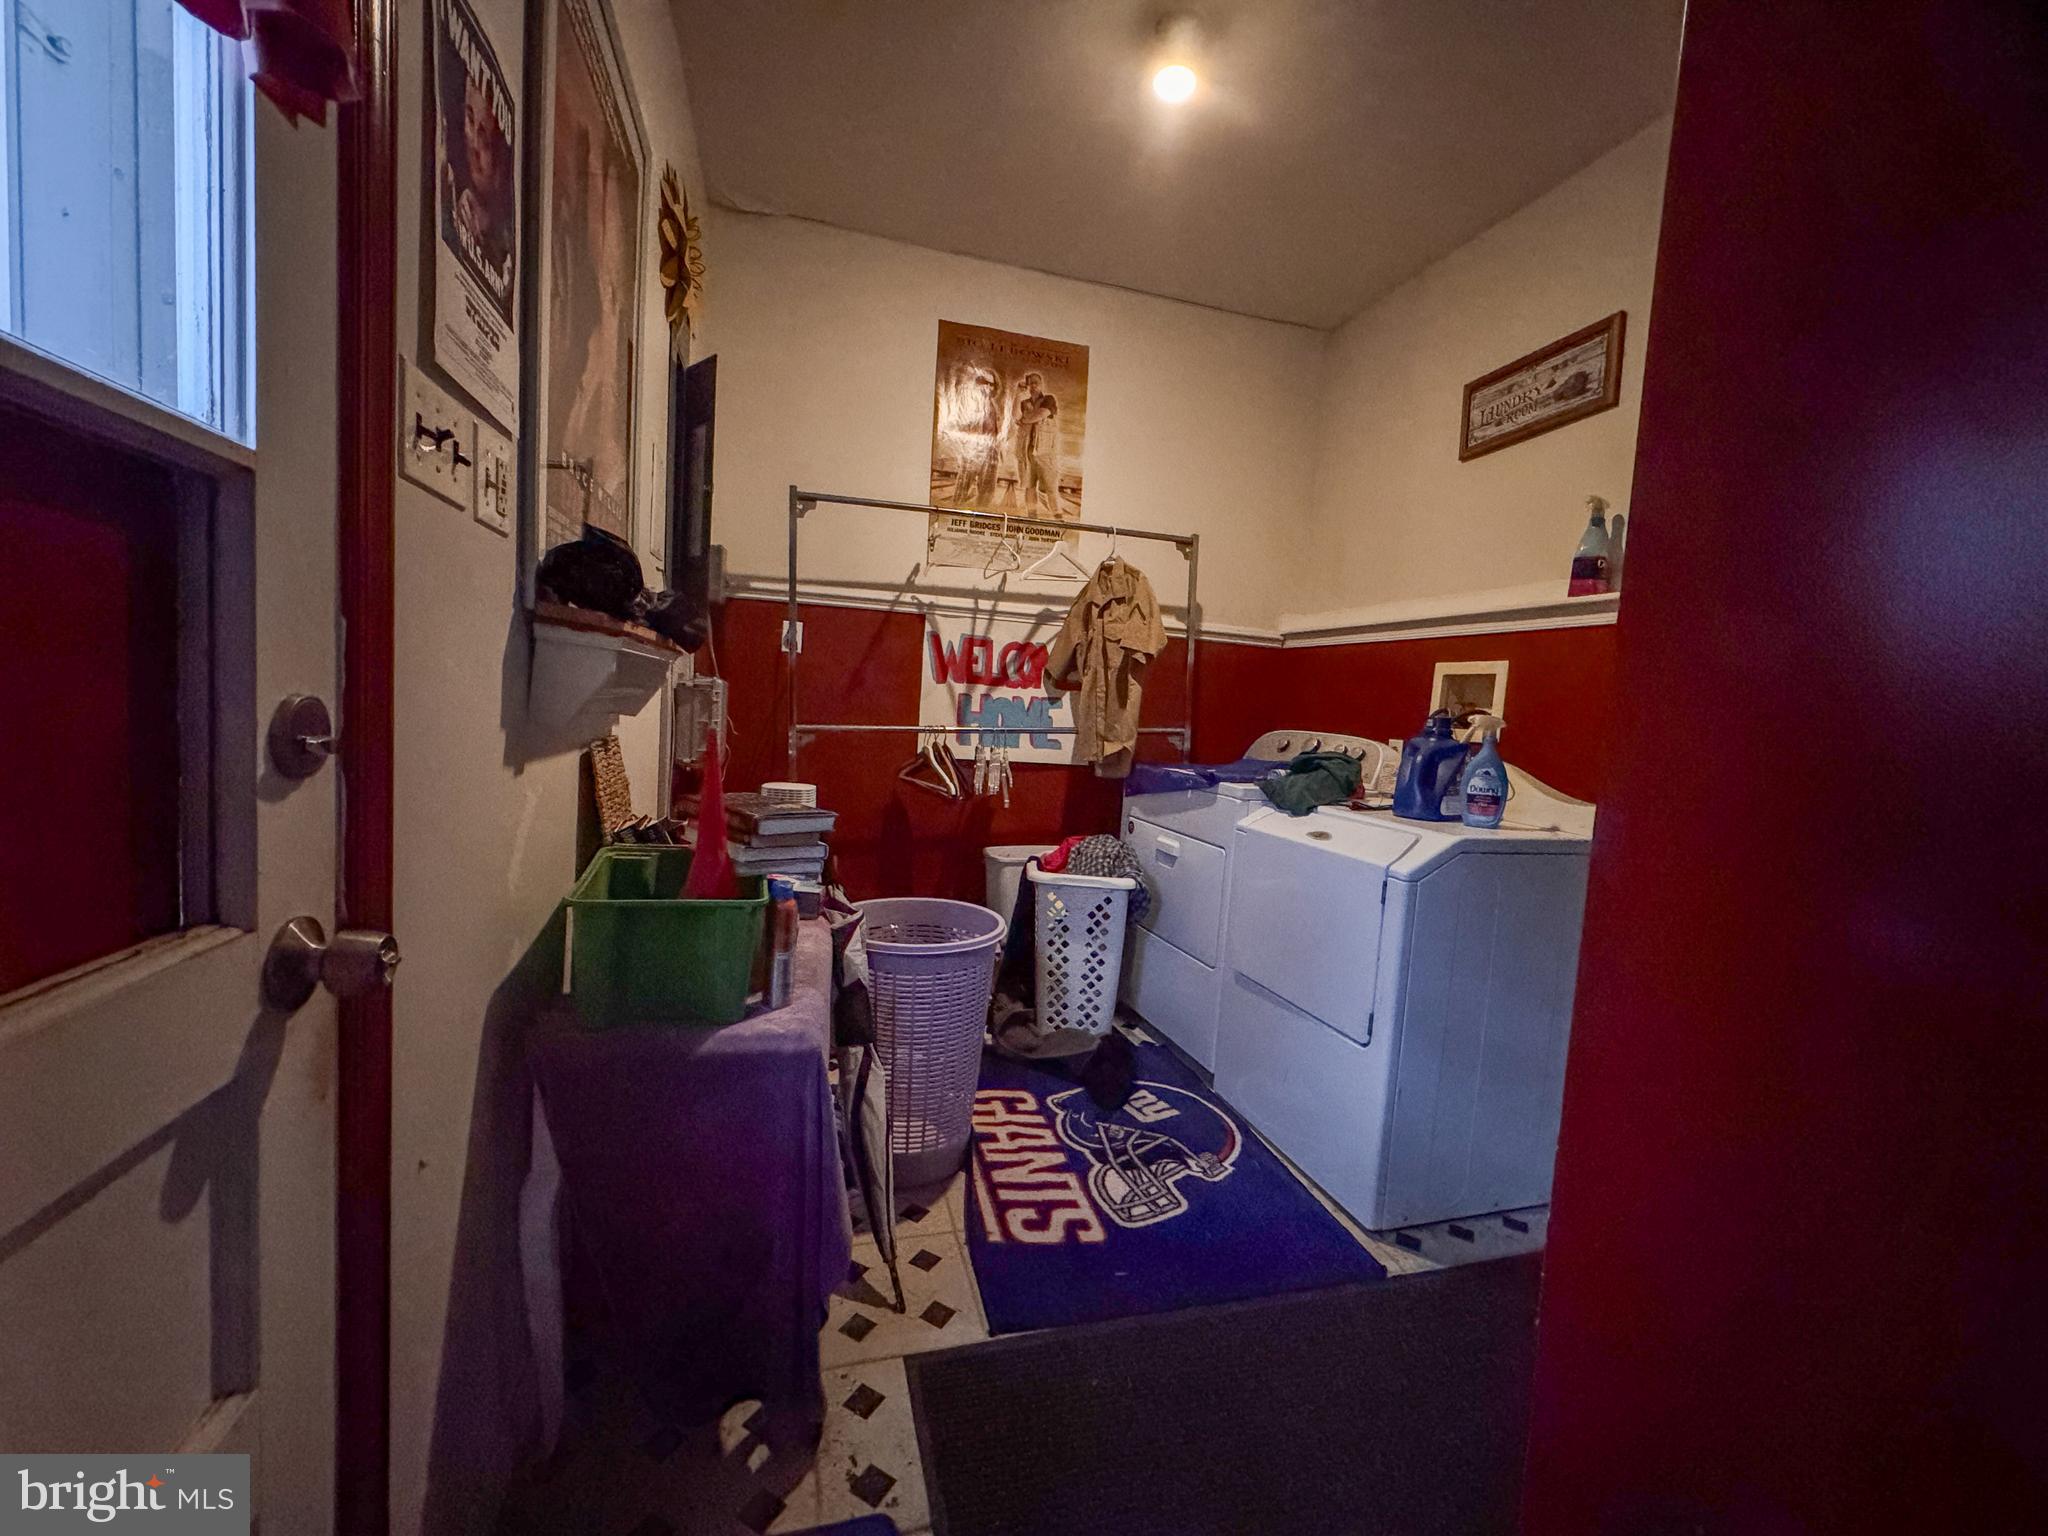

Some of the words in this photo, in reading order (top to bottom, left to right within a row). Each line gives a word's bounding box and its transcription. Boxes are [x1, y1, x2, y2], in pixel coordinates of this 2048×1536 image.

[446, 0, 491, 100] WANT
[491, 70, 512, 147] YOU
[1480, 387, 1540, 427] LAUNDRY
[1504, 401, 1537, 424] ROOM
[561, 450, 594, 492] BRUCE
[951, 519, 967, 528] JEFF
[969, 520, 1001, 531] BRIDGES
[1007, 524, 1024, 533] JOHN
[1025, 527, 1060, 538] GOODMAN
[956, 693, 1063, 750] HOME
[1470, 785, 1499, 796] Downy
[972, 1087, 1107, 1245] GIANTS
